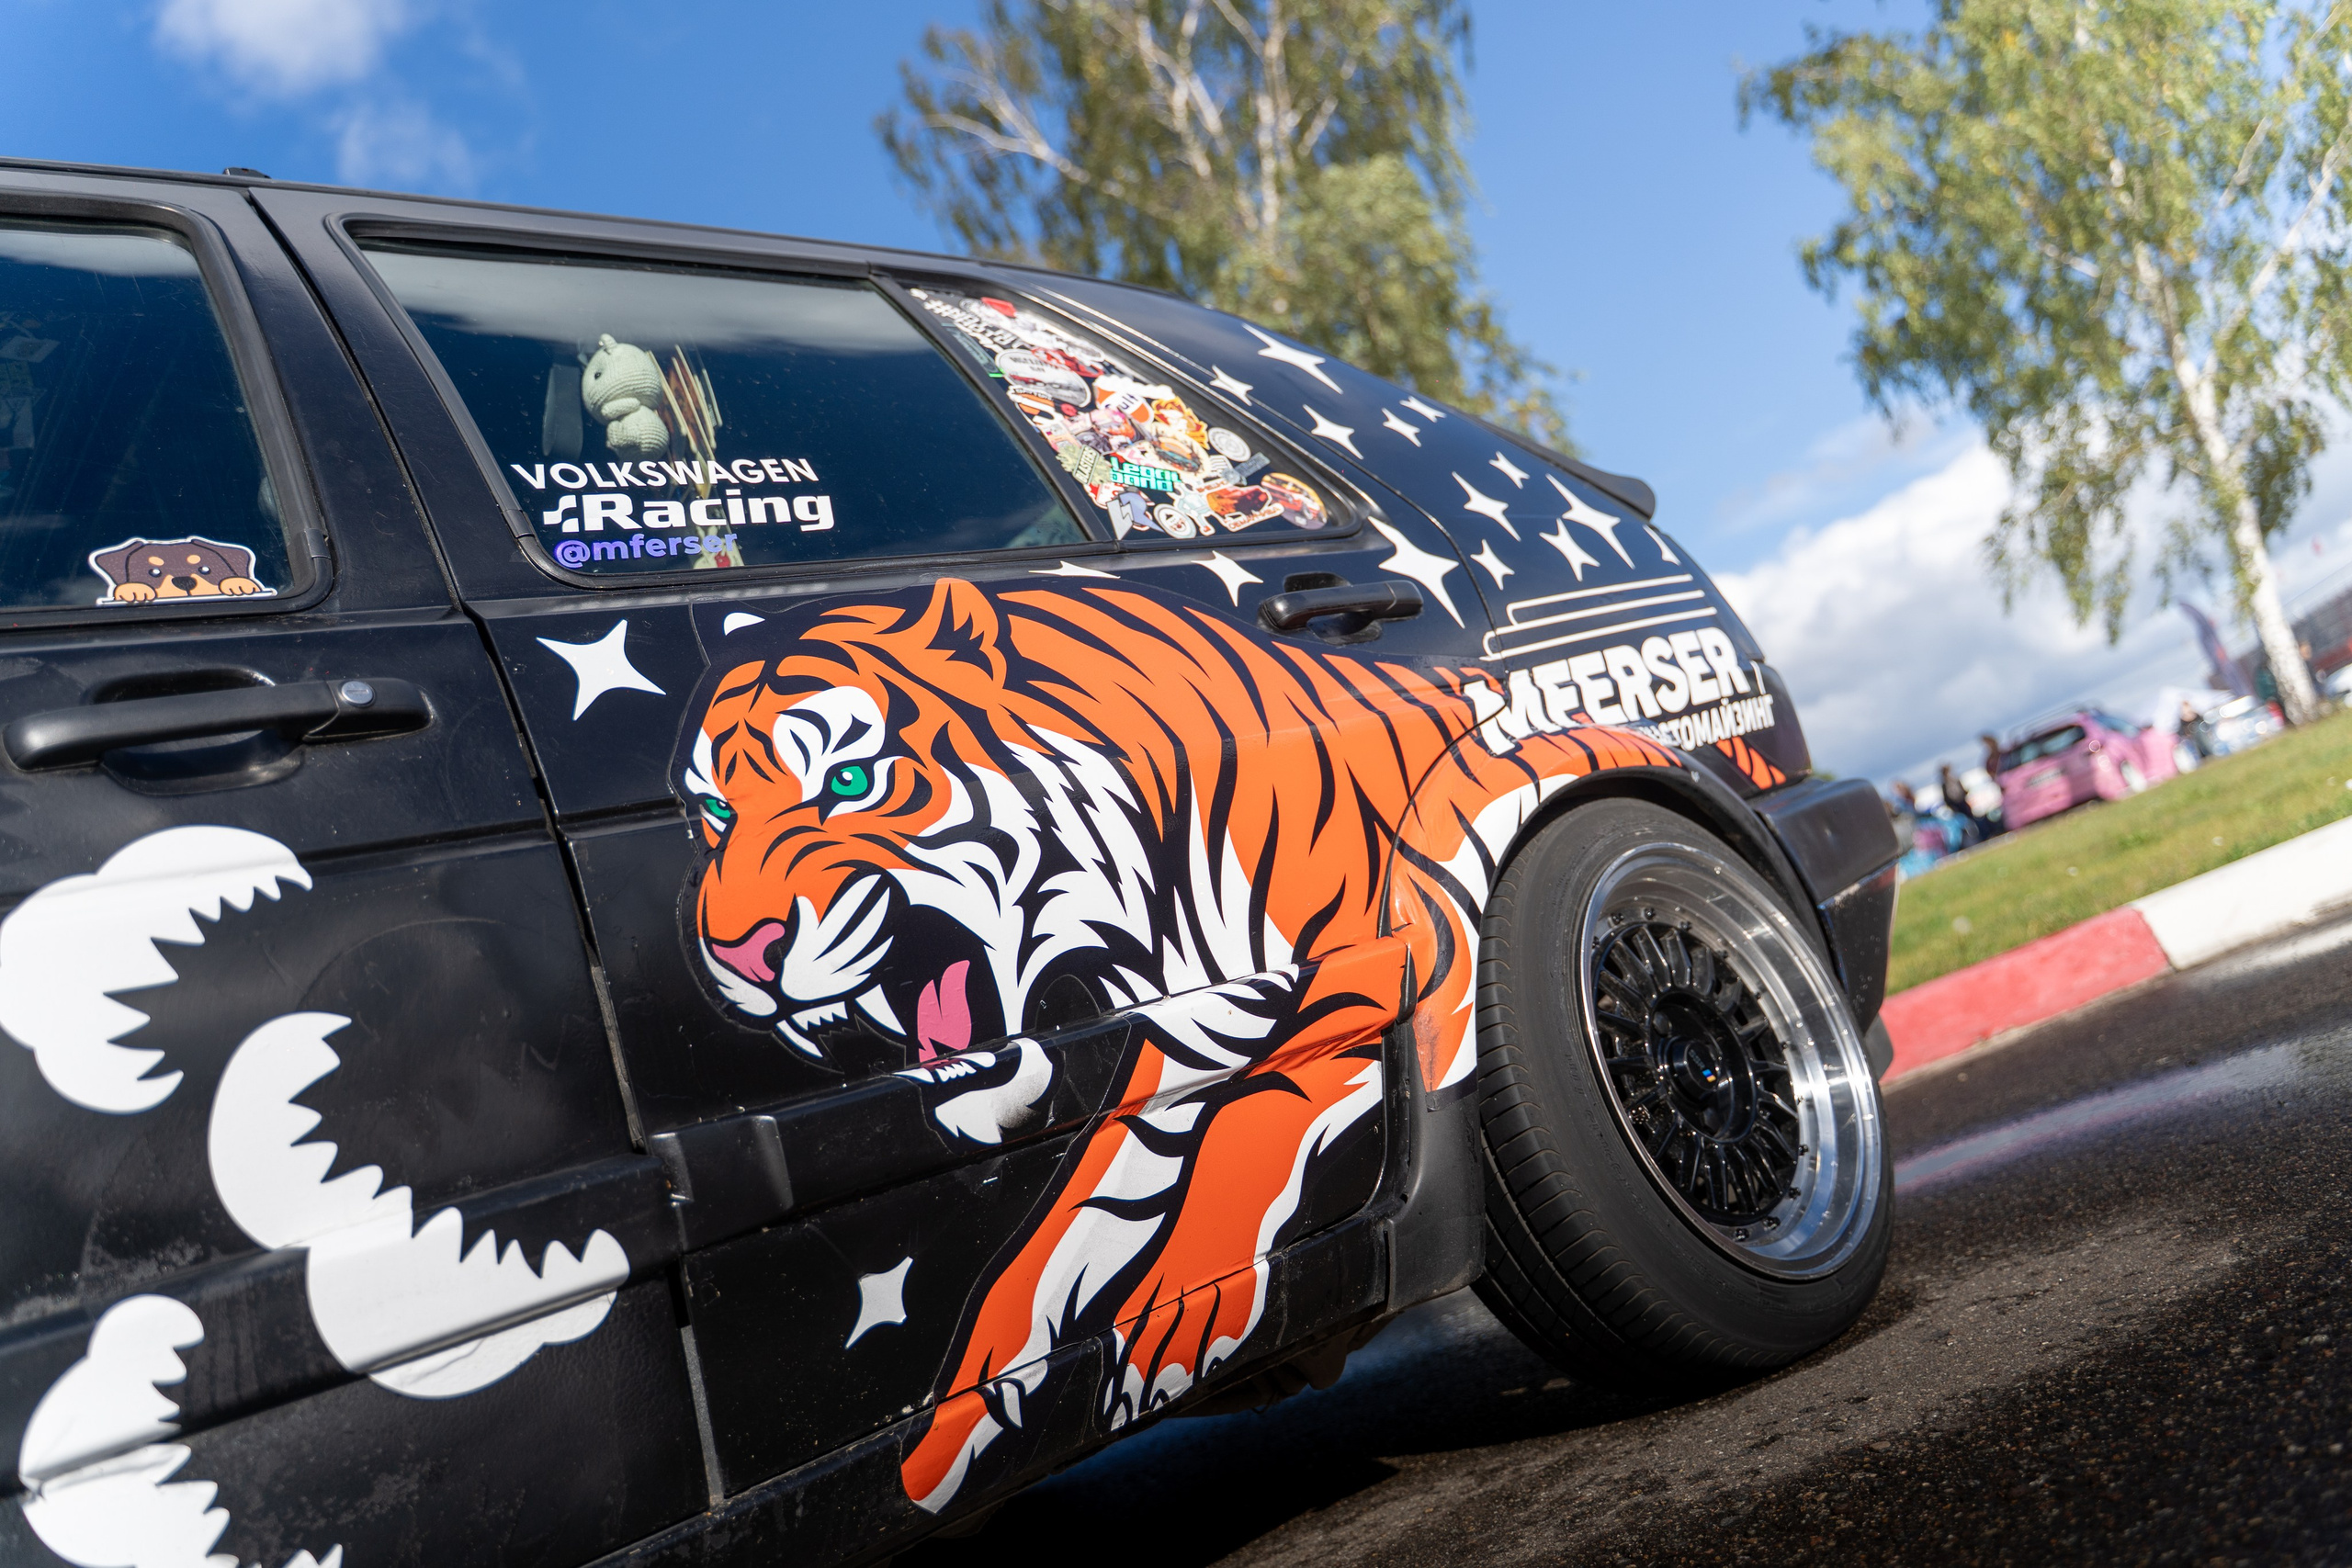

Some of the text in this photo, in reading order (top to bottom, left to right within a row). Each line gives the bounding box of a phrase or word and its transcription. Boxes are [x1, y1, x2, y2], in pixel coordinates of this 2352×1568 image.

[511, 458, 820, 490] VOLKSWAGEN
[582, 489, 835, 533] Racing
[554, 533, 738, 569] @mferser
[1464, 626, 1751, 757] MFERSER
